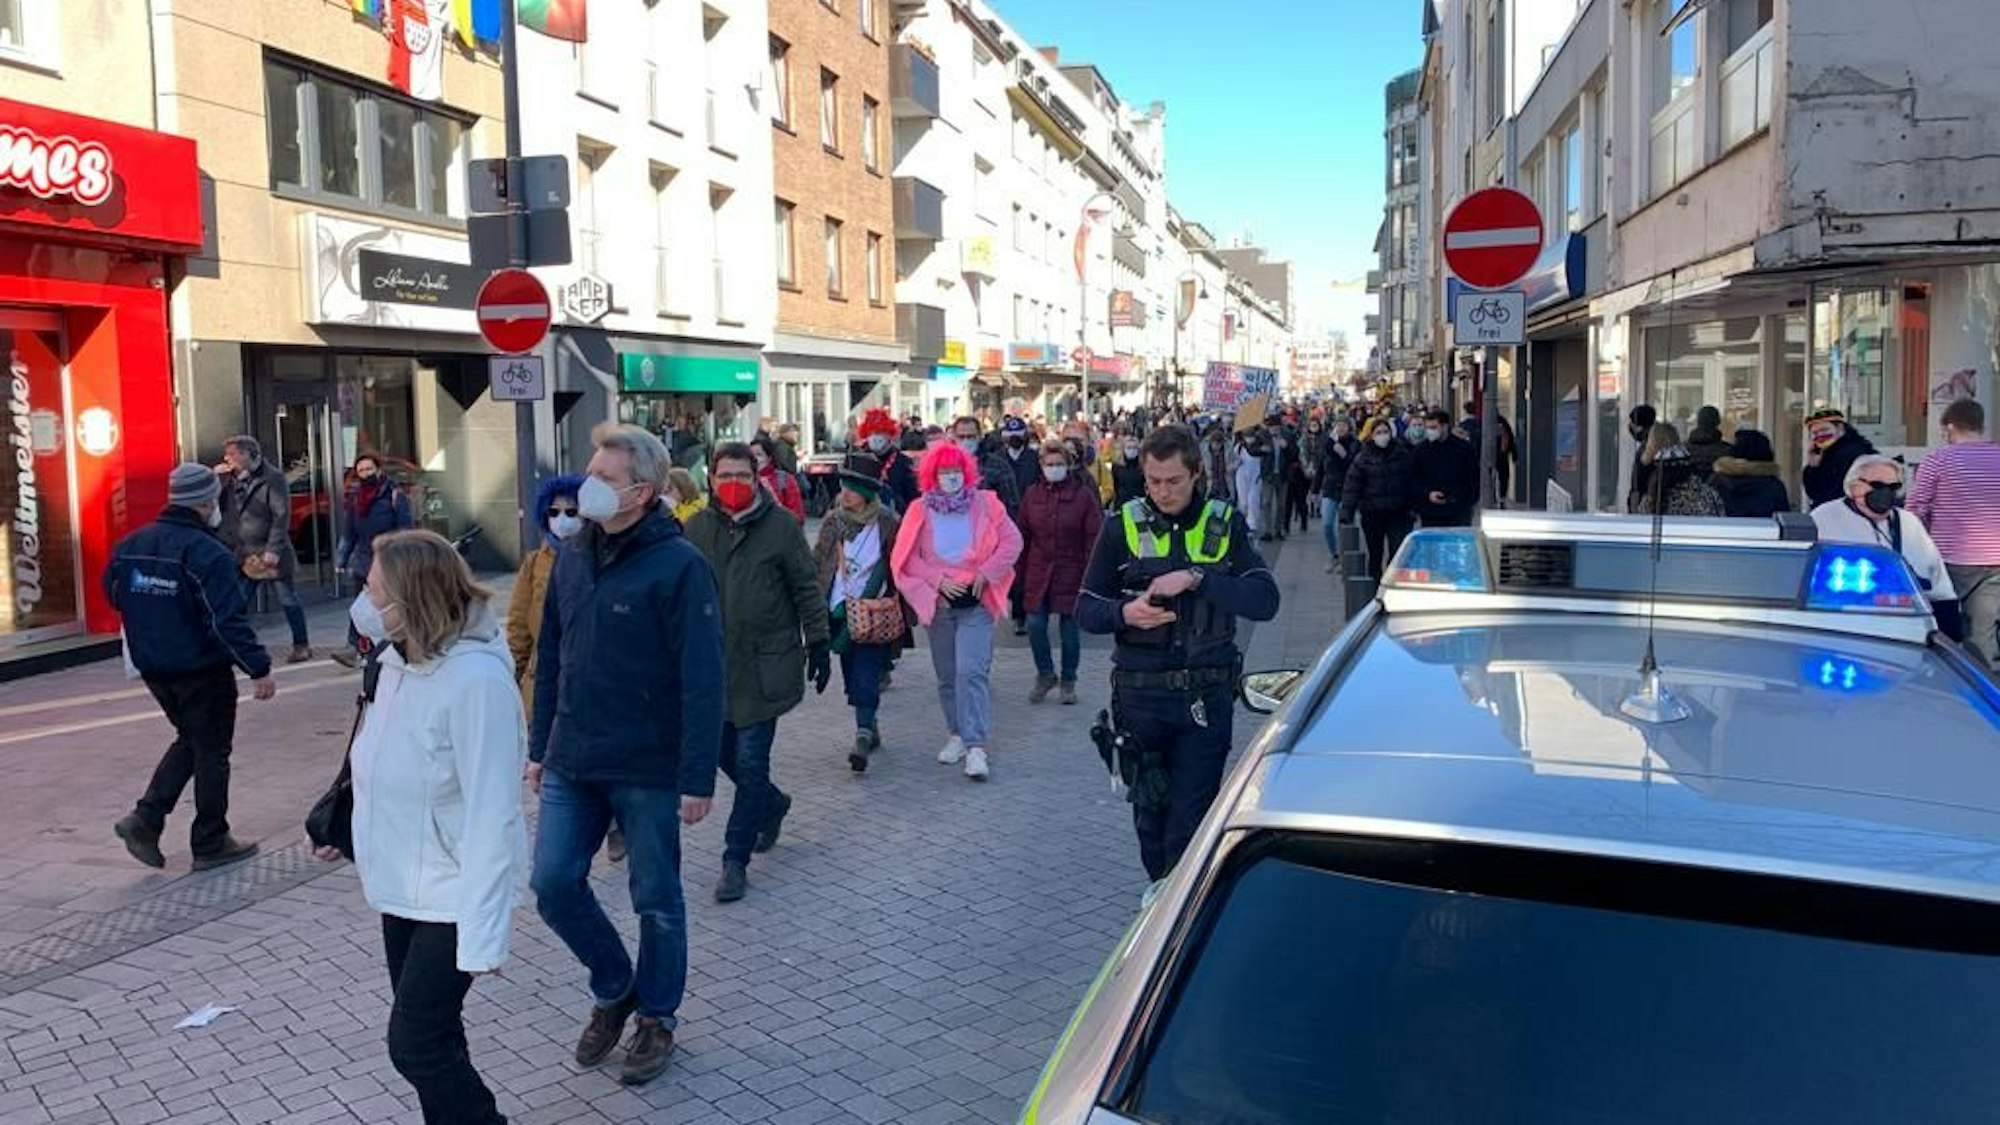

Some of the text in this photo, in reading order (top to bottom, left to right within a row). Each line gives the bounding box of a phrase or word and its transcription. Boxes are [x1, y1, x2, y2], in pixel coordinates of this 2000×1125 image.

[1478, 326, 1501, 338] frei
[509, 384, 526, 397] frei
[9, 354, 42, 614] Weltmeister
